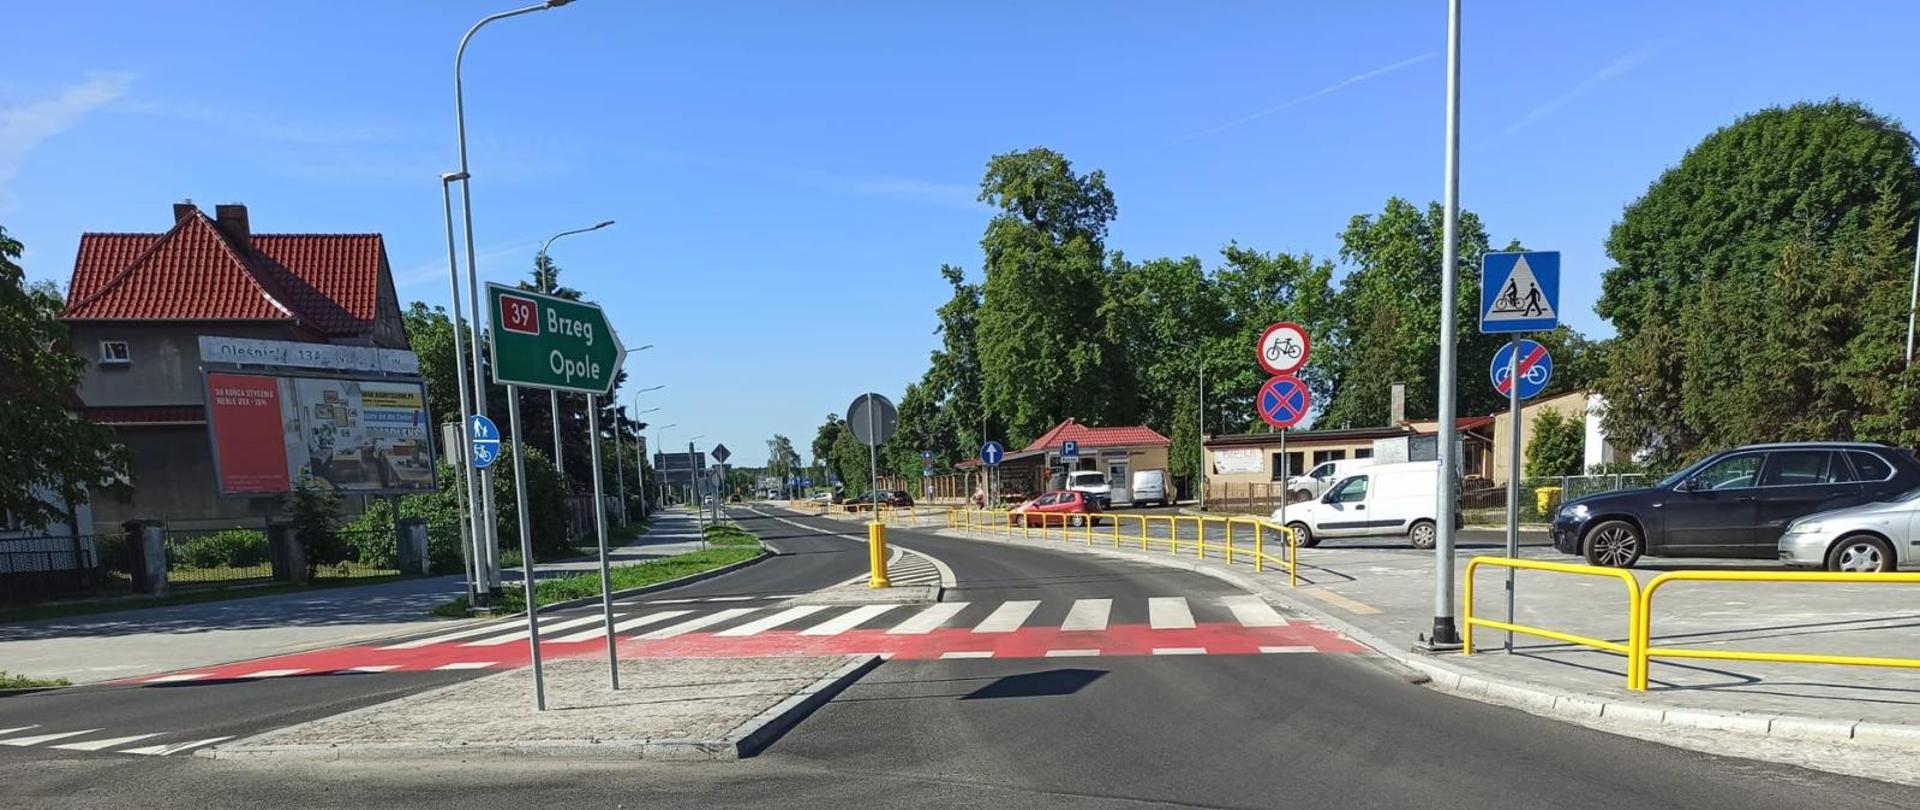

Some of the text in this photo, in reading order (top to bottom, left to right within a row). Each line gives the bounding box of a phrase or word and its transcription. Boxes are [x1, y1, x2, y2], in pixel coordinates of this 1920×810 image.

[511, 303, 529, 326] 39
[547, 307, 592, 346] Brzeg
[550, 350, 600, 383] Opole
[1065, 442, 1074, 453] P
